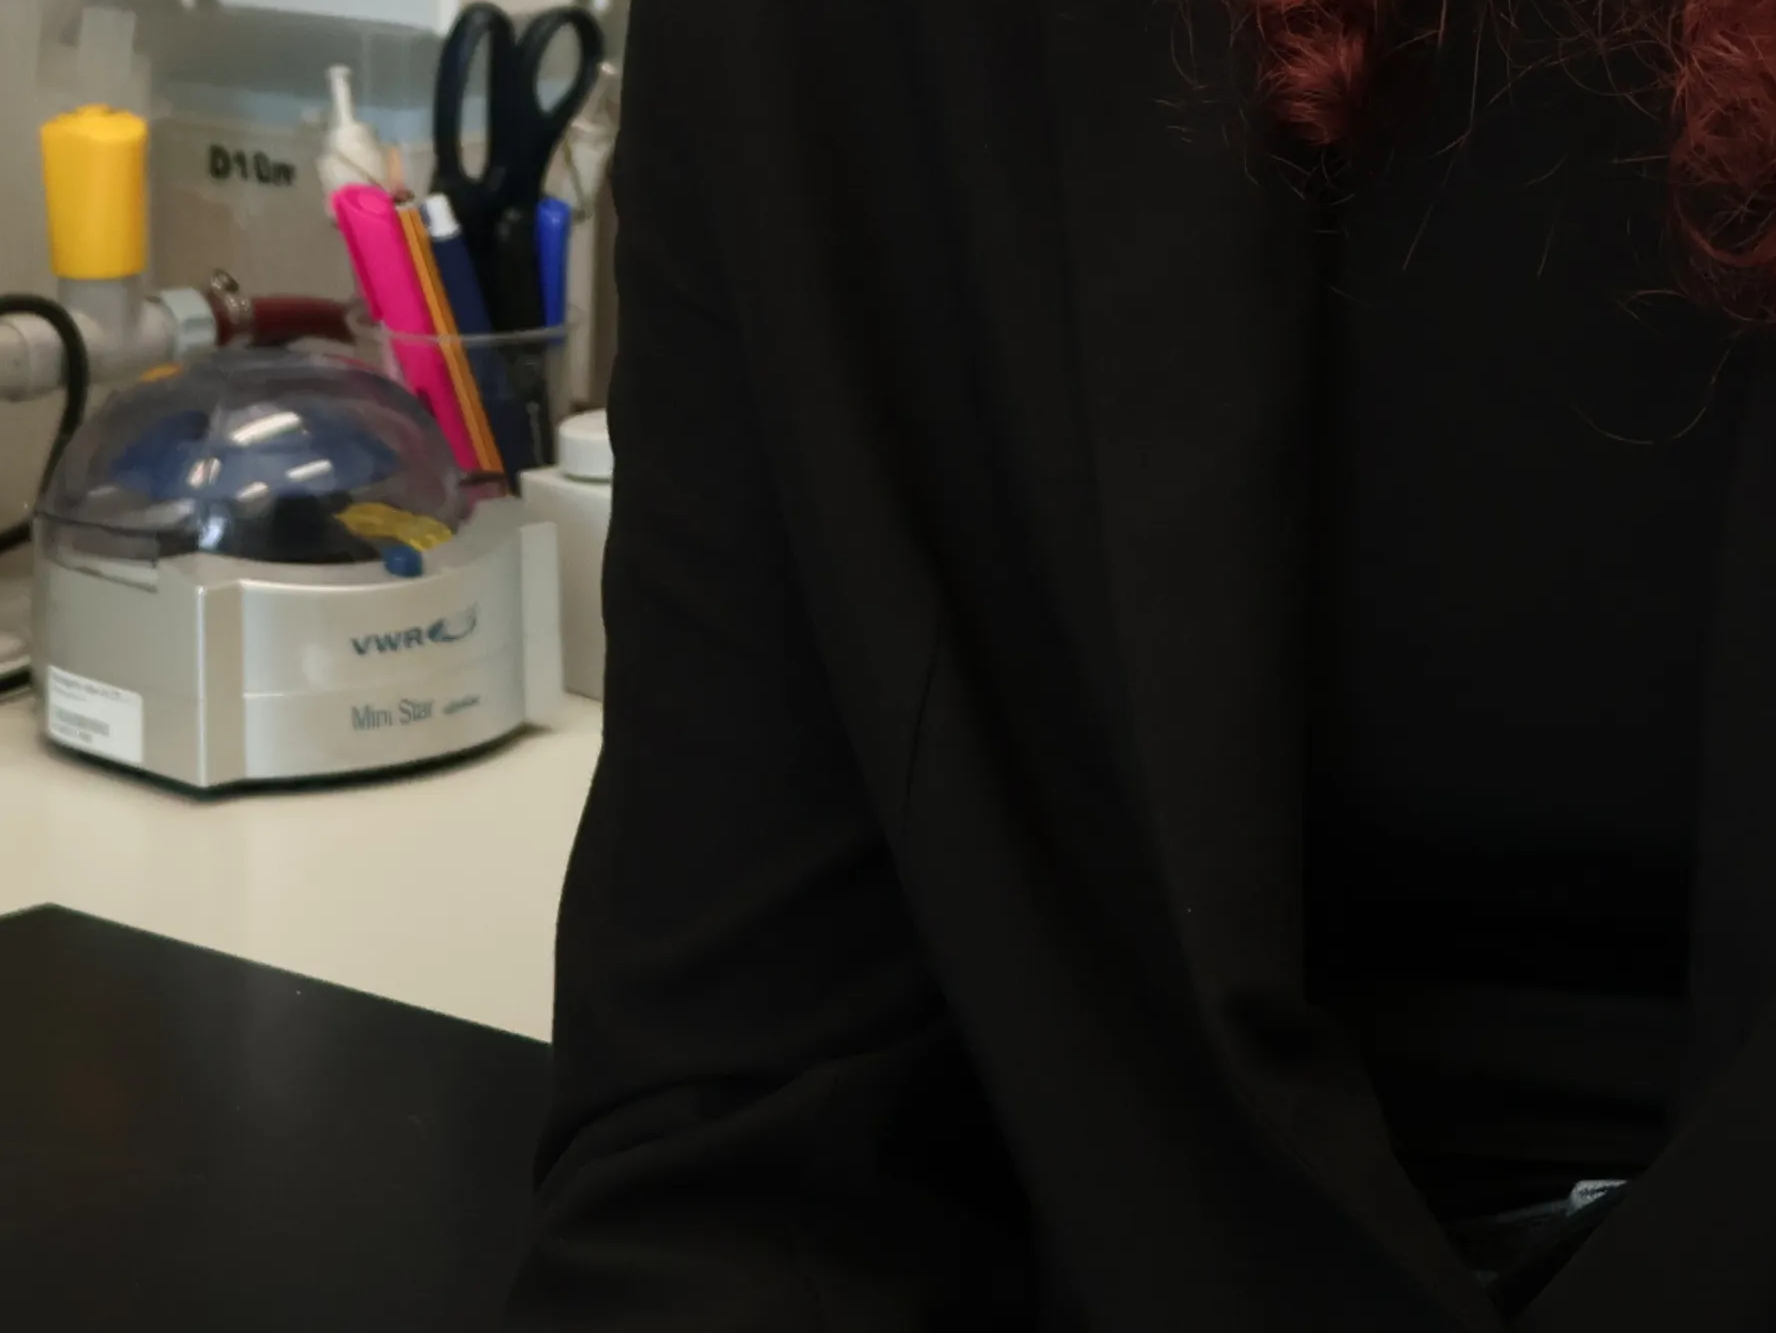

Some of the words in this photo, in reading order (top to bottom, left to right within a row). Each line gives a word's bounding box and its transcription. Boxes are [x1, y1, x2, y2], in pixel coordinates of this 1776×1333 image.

[350, 626, 424, 656] VWR
[351, 703, 392, 731] Mini
[398, 697, 435, 725] Star
